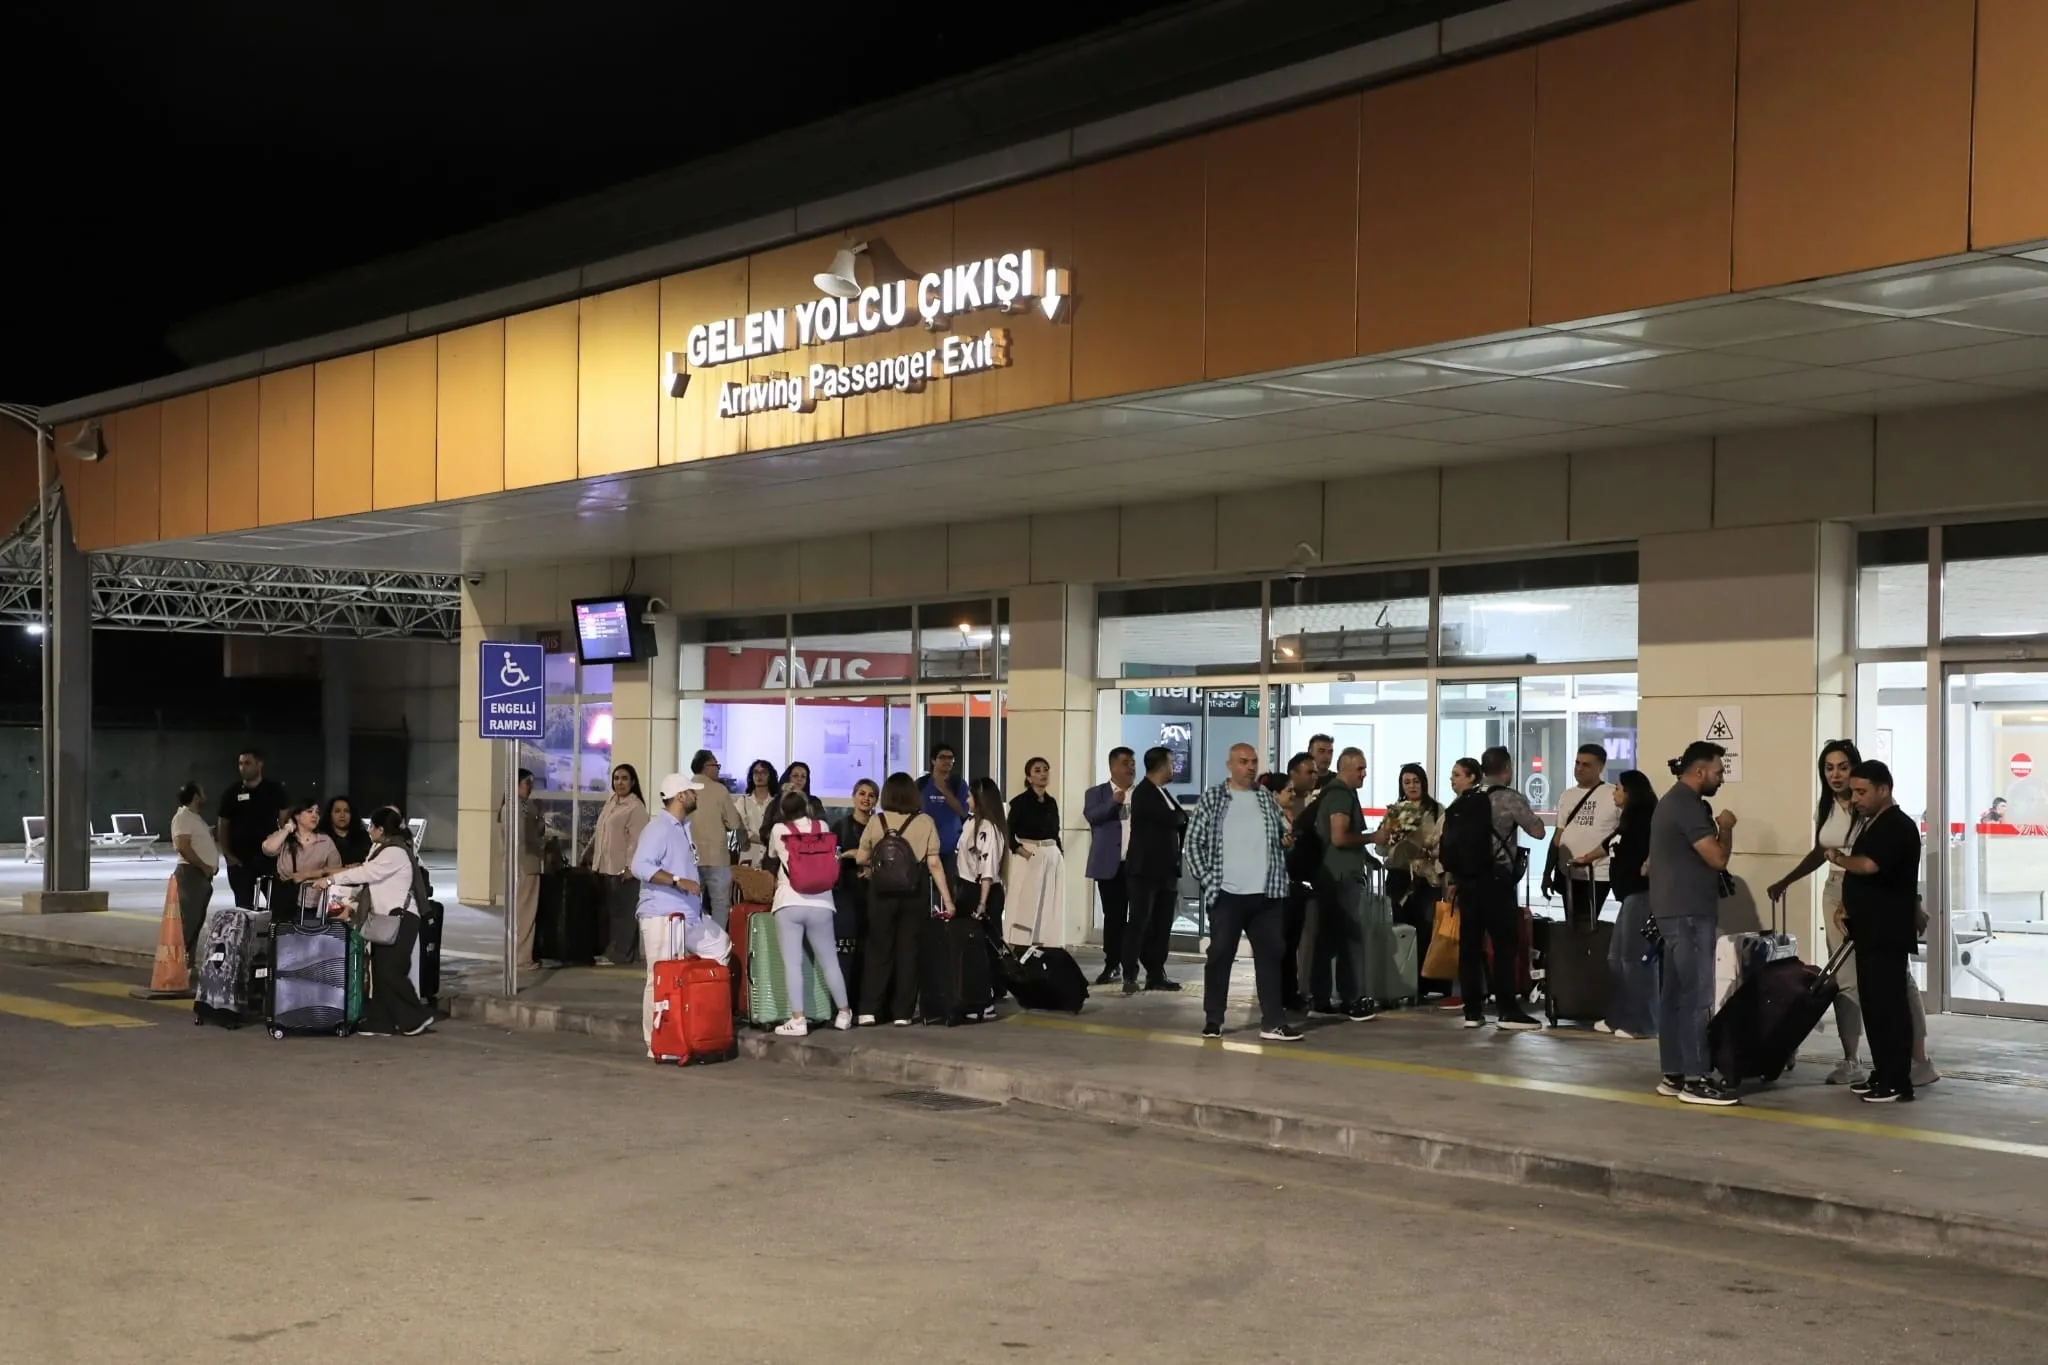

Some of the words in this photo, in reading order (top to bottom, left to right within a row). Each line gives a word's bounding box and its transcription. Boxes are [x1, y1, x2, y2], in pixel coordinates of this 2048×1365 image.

[687, 307, 785, 367] GELEN
[795, 280, 906, 345] YOLCU
[918, 249, 1032, 329] ÇIKIŞI
[809, 348, 936, 399] Passenger
[761, 655, 872, 702] AVIS
[489, 719, 537, 731] RAMPASI
[490, 701, 536, 715] ENGELLİ
